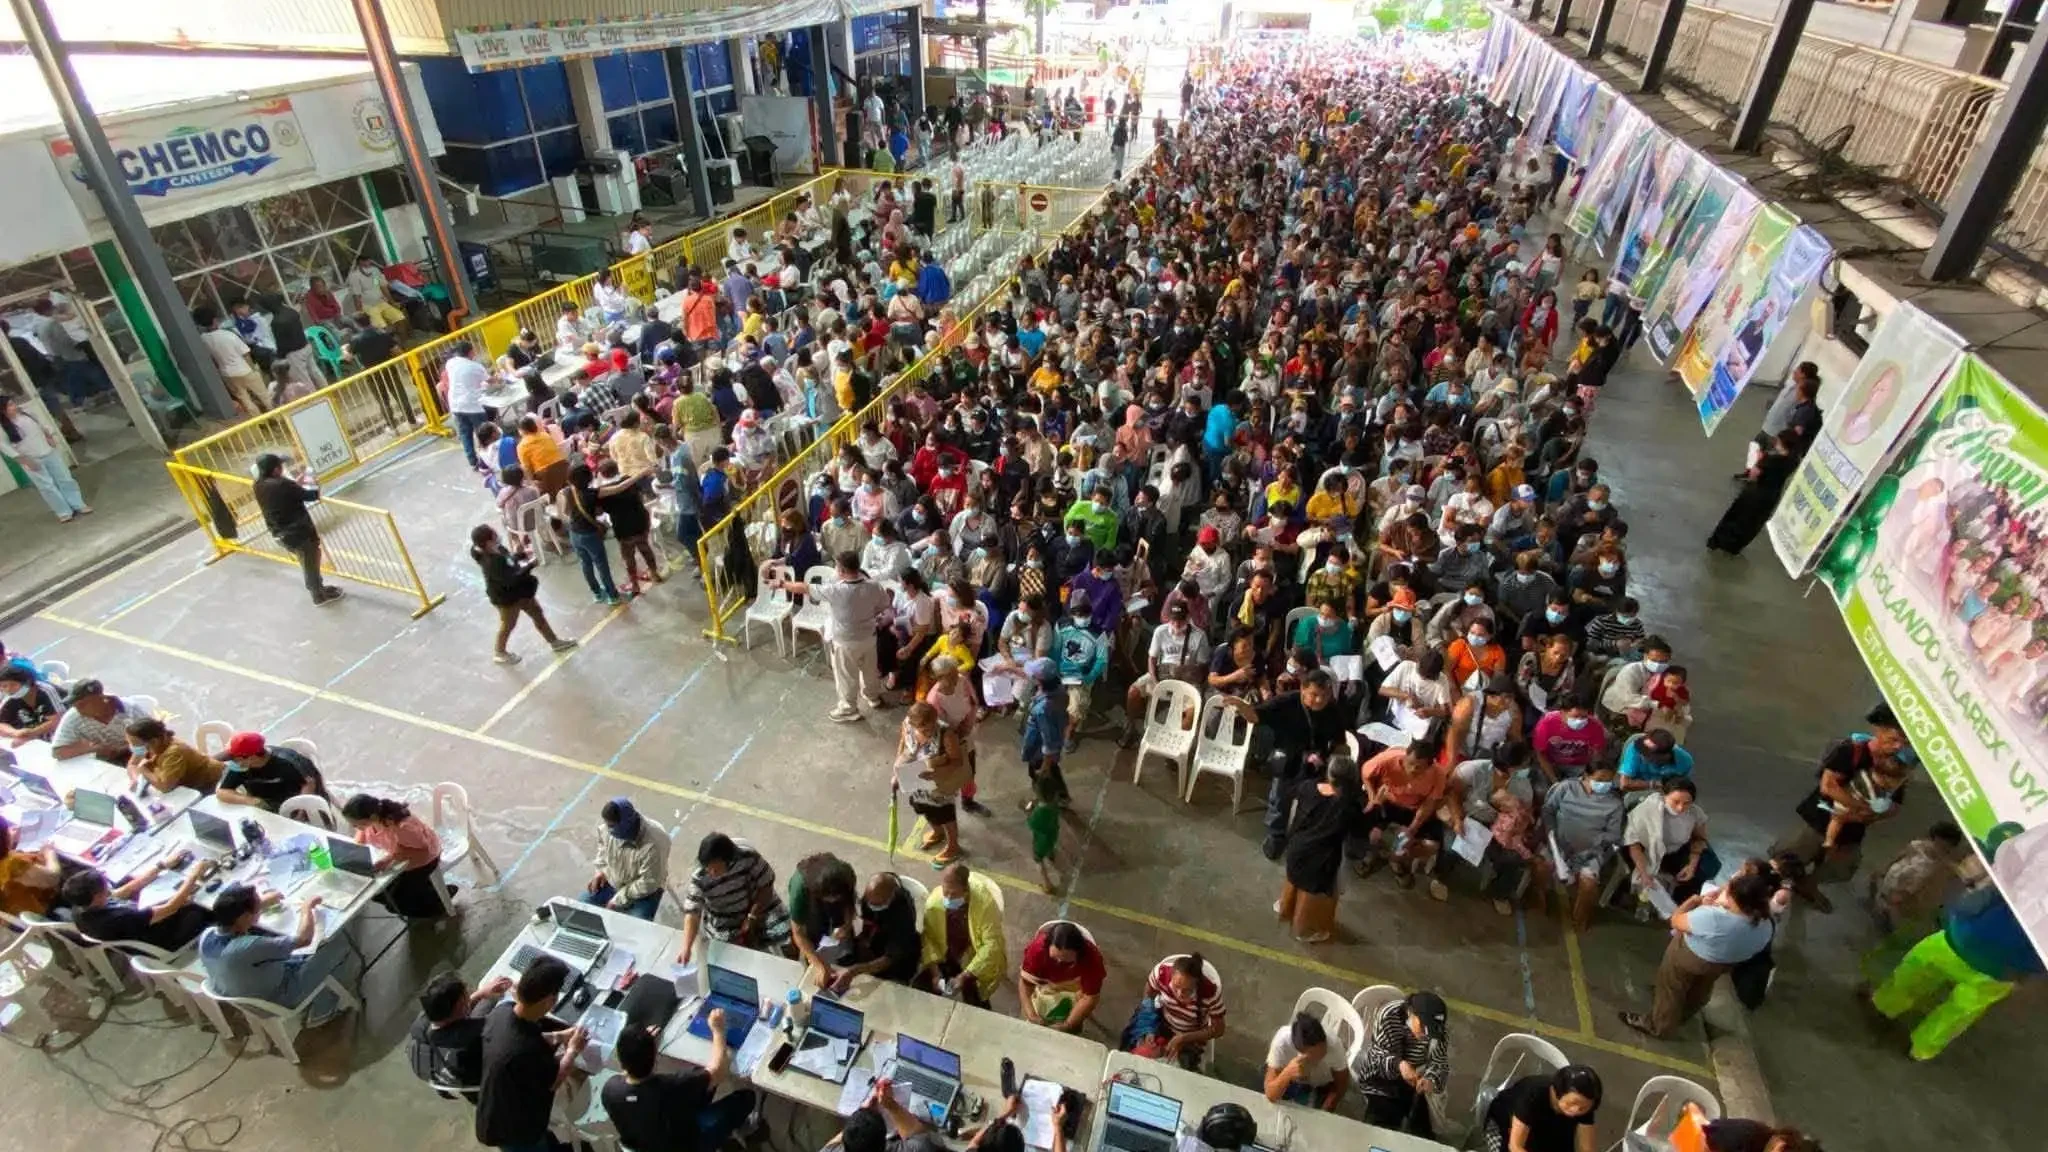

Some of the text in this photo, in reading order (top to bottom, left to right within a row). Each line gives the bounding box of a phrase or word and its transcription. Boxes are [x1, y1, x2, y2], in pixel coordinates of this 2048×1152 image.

[115, 123, 271, 182] CHEMCO
[169, 165, 235, 187] CANTEEN
[320, 441, 333, 452] NO
[1871, 561, 1940, 662] ROLANDO
[1926, 735, 1979, 811] OFFICE
